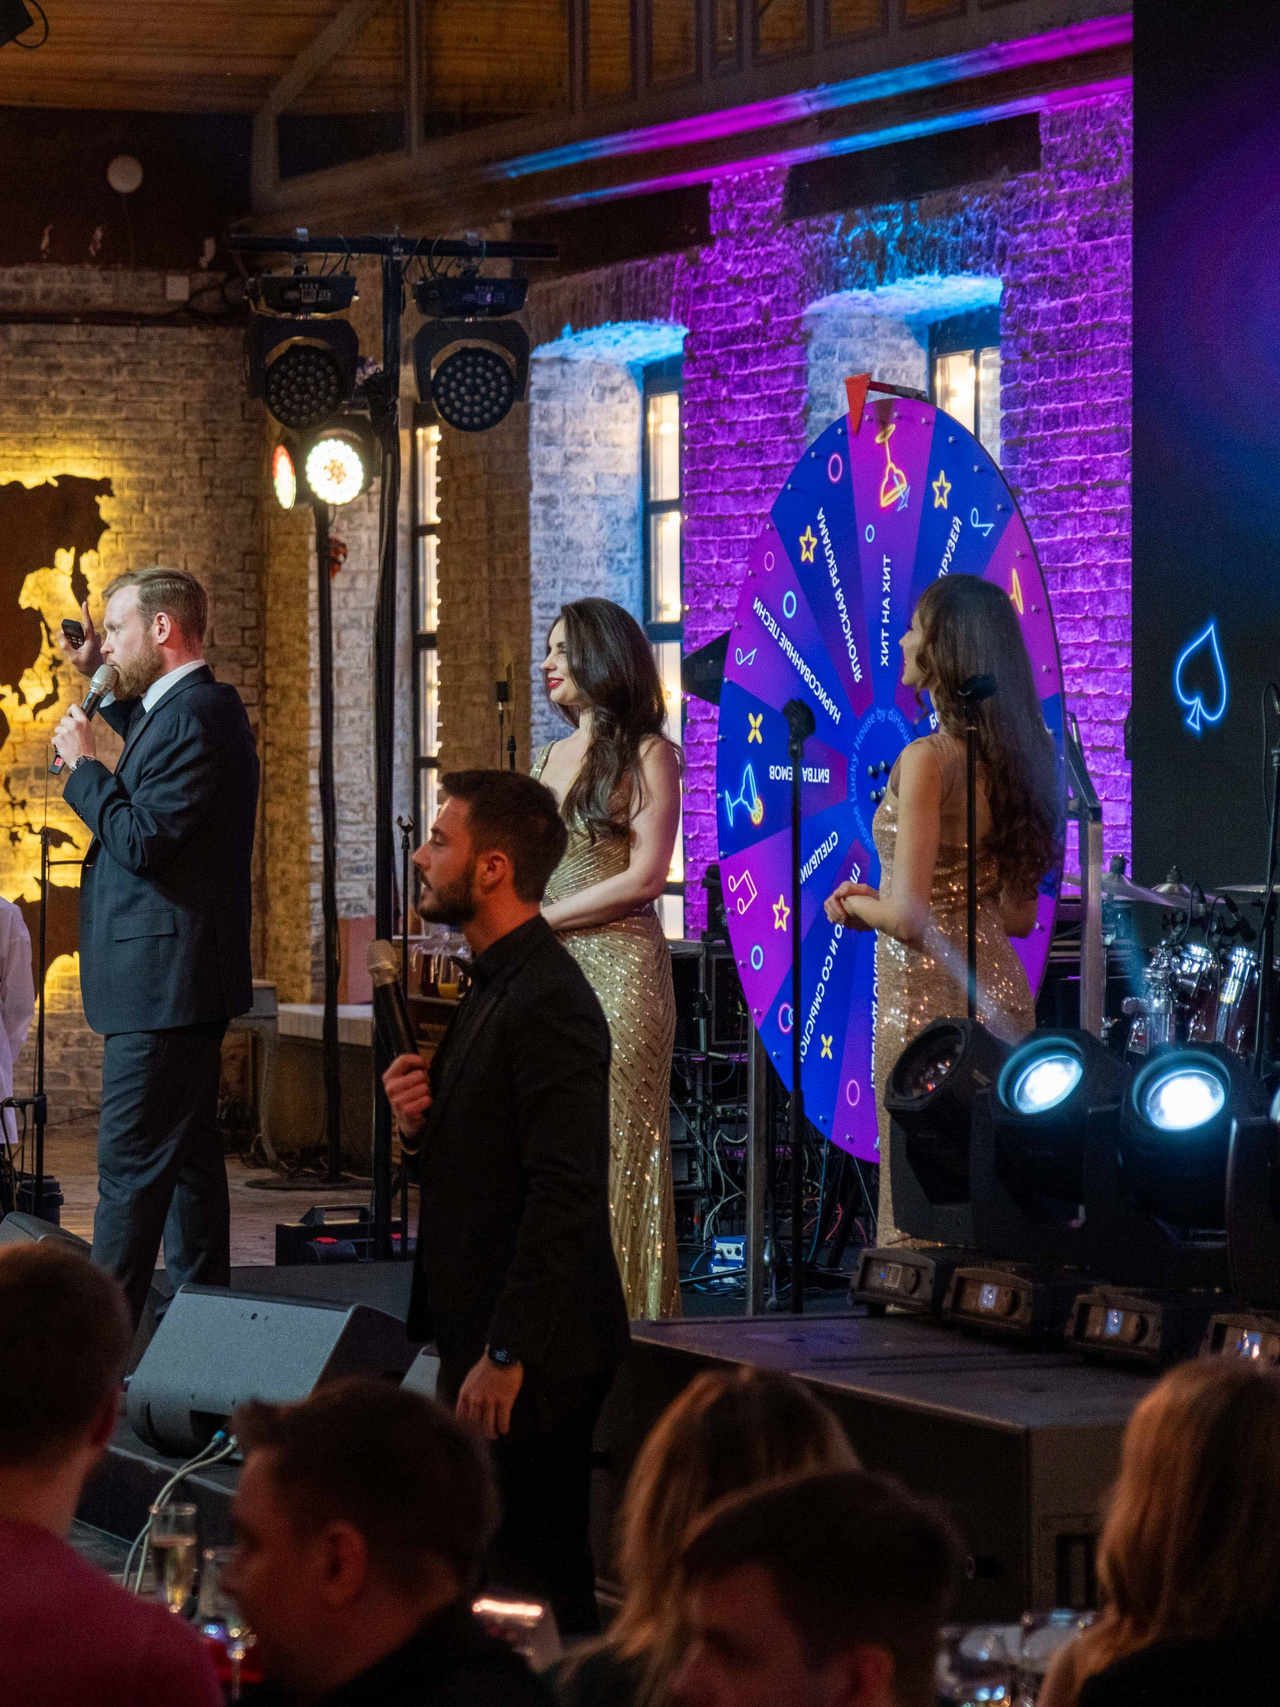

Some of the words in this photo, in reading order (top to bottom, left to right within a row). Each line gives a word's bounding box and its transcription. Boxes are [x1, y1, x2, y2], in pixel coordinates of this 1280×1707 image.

[816, 507, 840, 588] РЕКЛАМА
[882, 554, 891, 593] ХИТ
[752, 596, 781, 640] ПЕСНИ
[881, 597, 890, 624] НА
[834, 587, 863, 683] ЯПОНСКАЯ
[880, 627, 889, 667] ХИТ
[778, 632, 841, 725] НАРИСОВАННЫЕ
[769, 764, 793, 781] ЕМОВ
[849, 752, 859, 802] Lucky
[854, 713, 876, 751] House
[876, 706, 887, 723] by
[887, 707, 911, 746] diHous
[801, 767, 830, 784] БИТВА
[800, 831, 839, 885] СПЕЦБЛИ
[829, 938, 839, 956] И
[821, 955, 833, 982] СО
[799, 982, 825, 1063] СМЫСЛО
